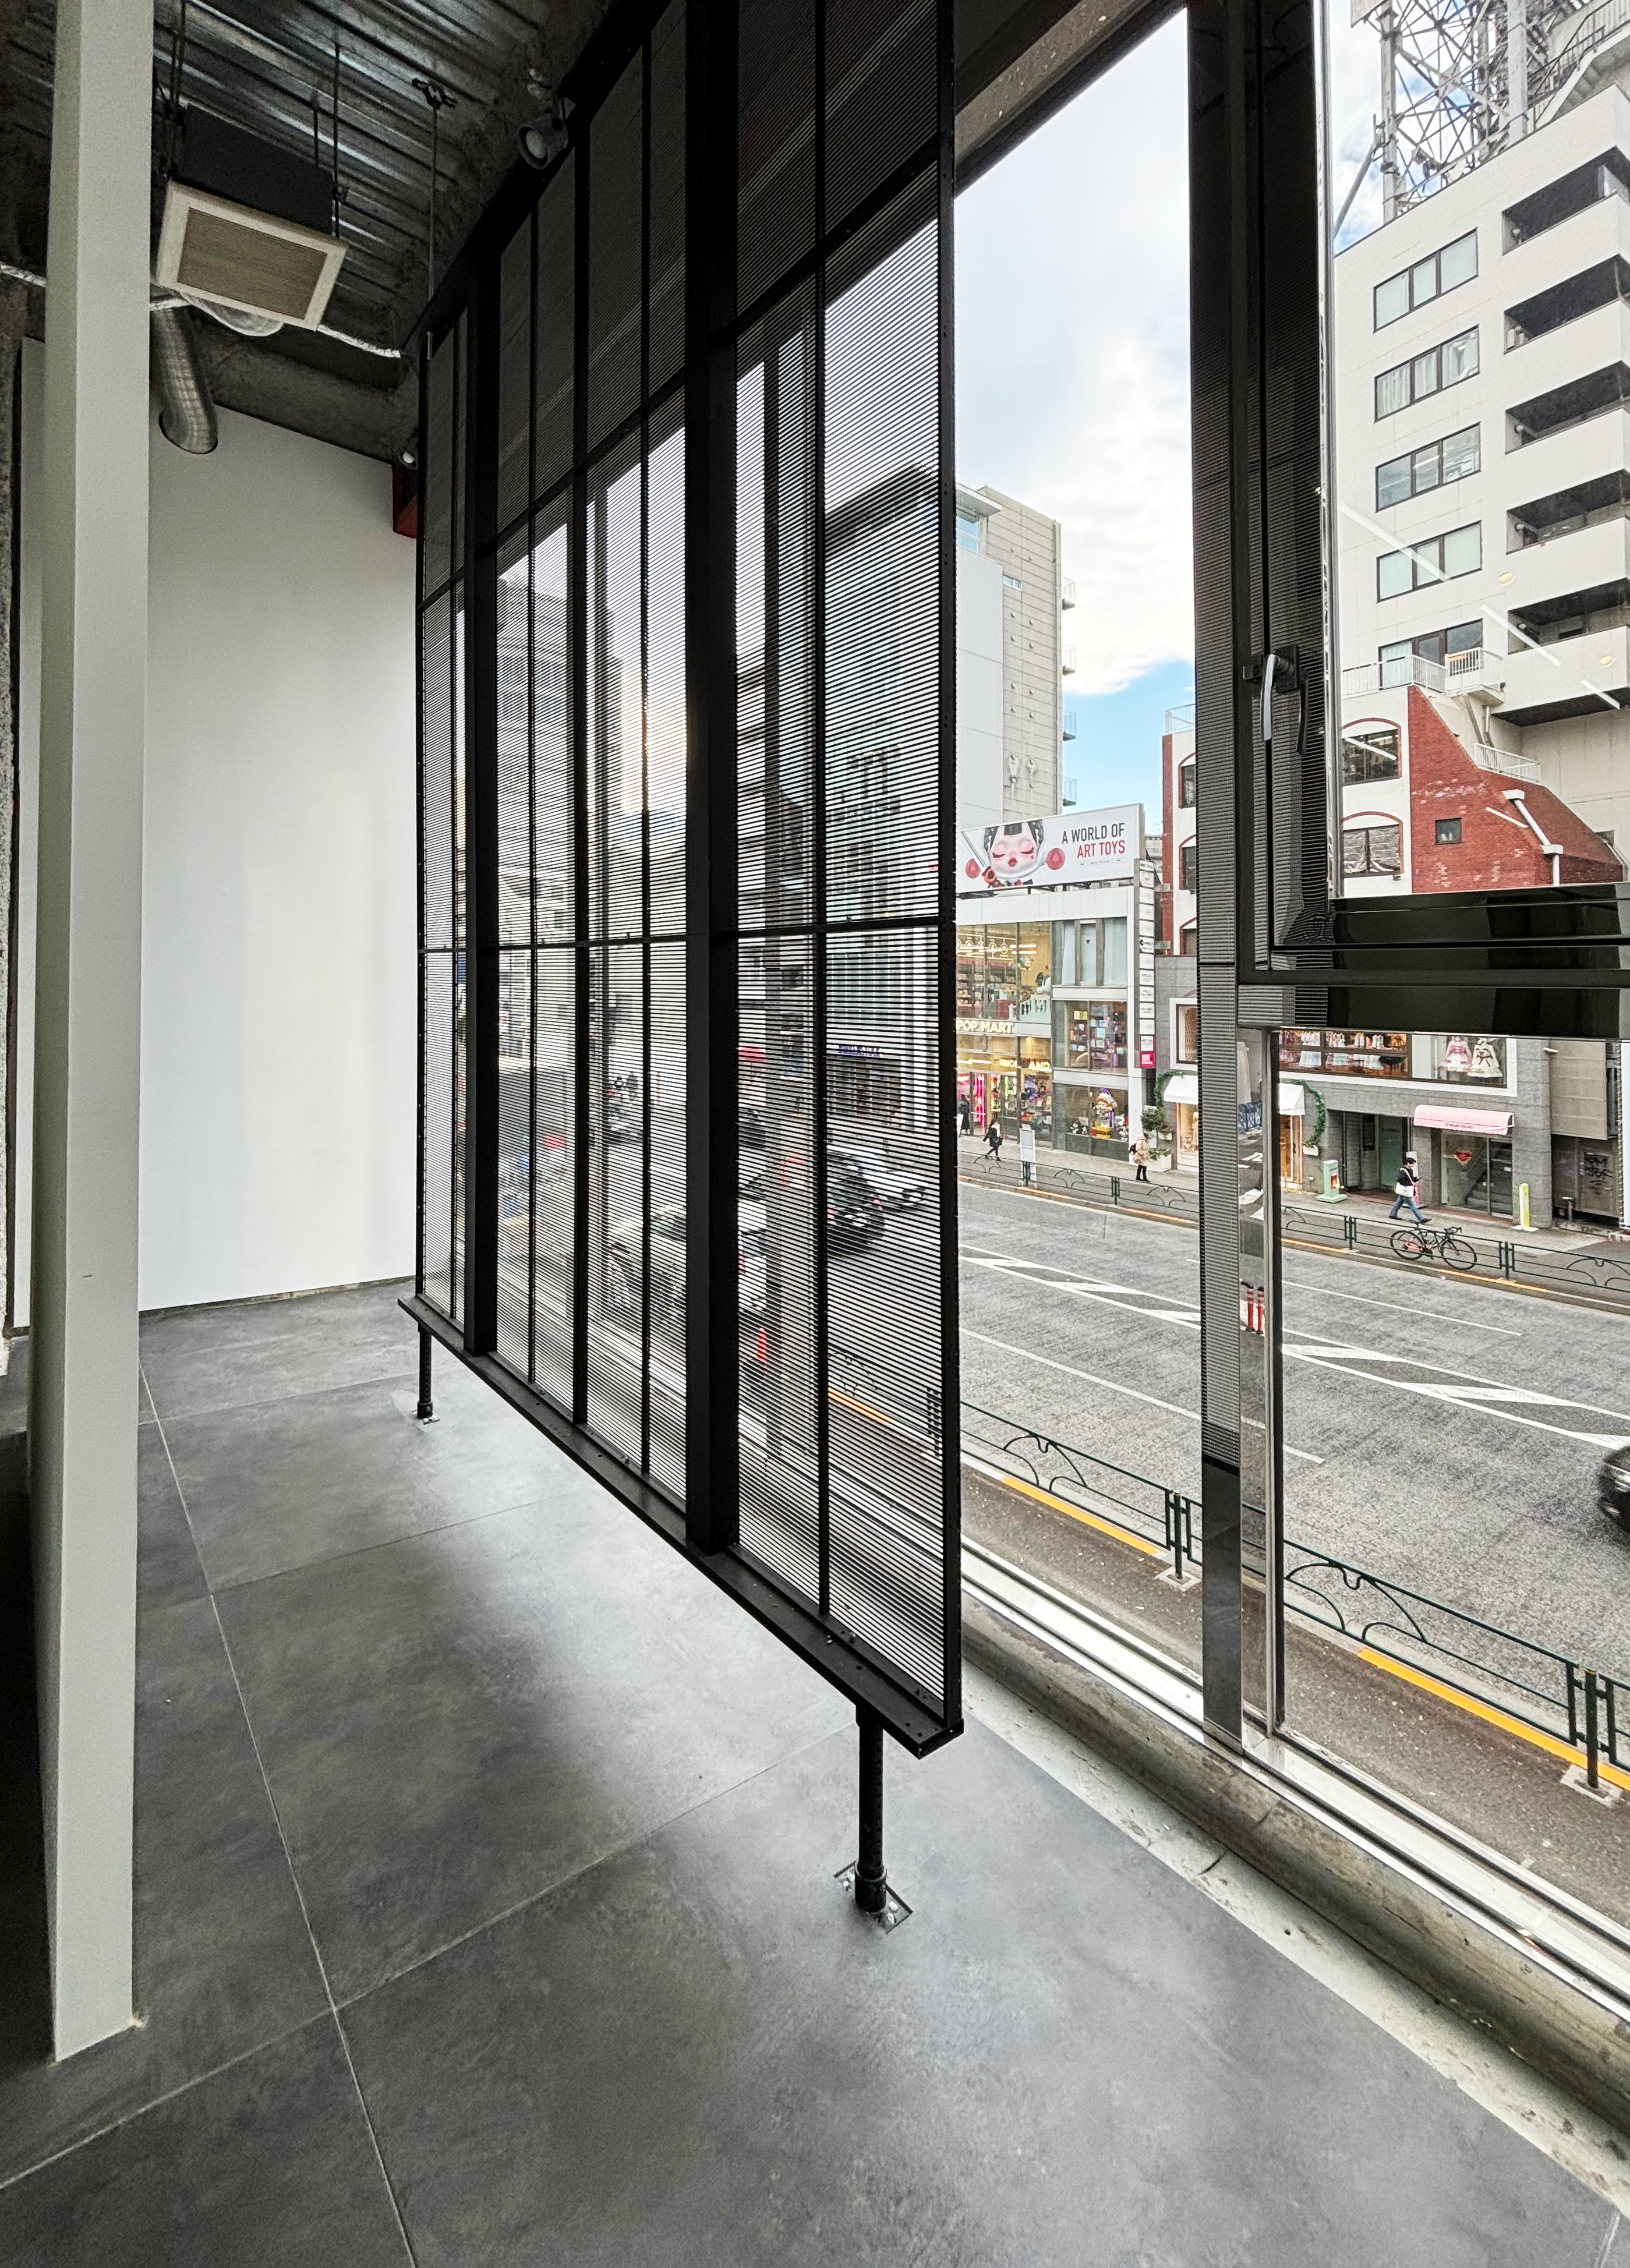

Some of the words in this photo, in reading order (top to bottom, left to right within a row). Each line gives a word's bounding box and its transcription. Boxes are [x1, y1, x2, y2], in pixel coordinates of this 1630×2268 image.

[1062, 830, 1068, 844] A
[1071, 825, 1107, 843] WORLD
[1111, 822, 1125, 837] OF
[1077, 843, 1096, 858] ART
[1099, 840, 1125, 855] TOYS
[956, 1020, 978, 1031] POP
[981, 1021, 1013, 1034] MART
